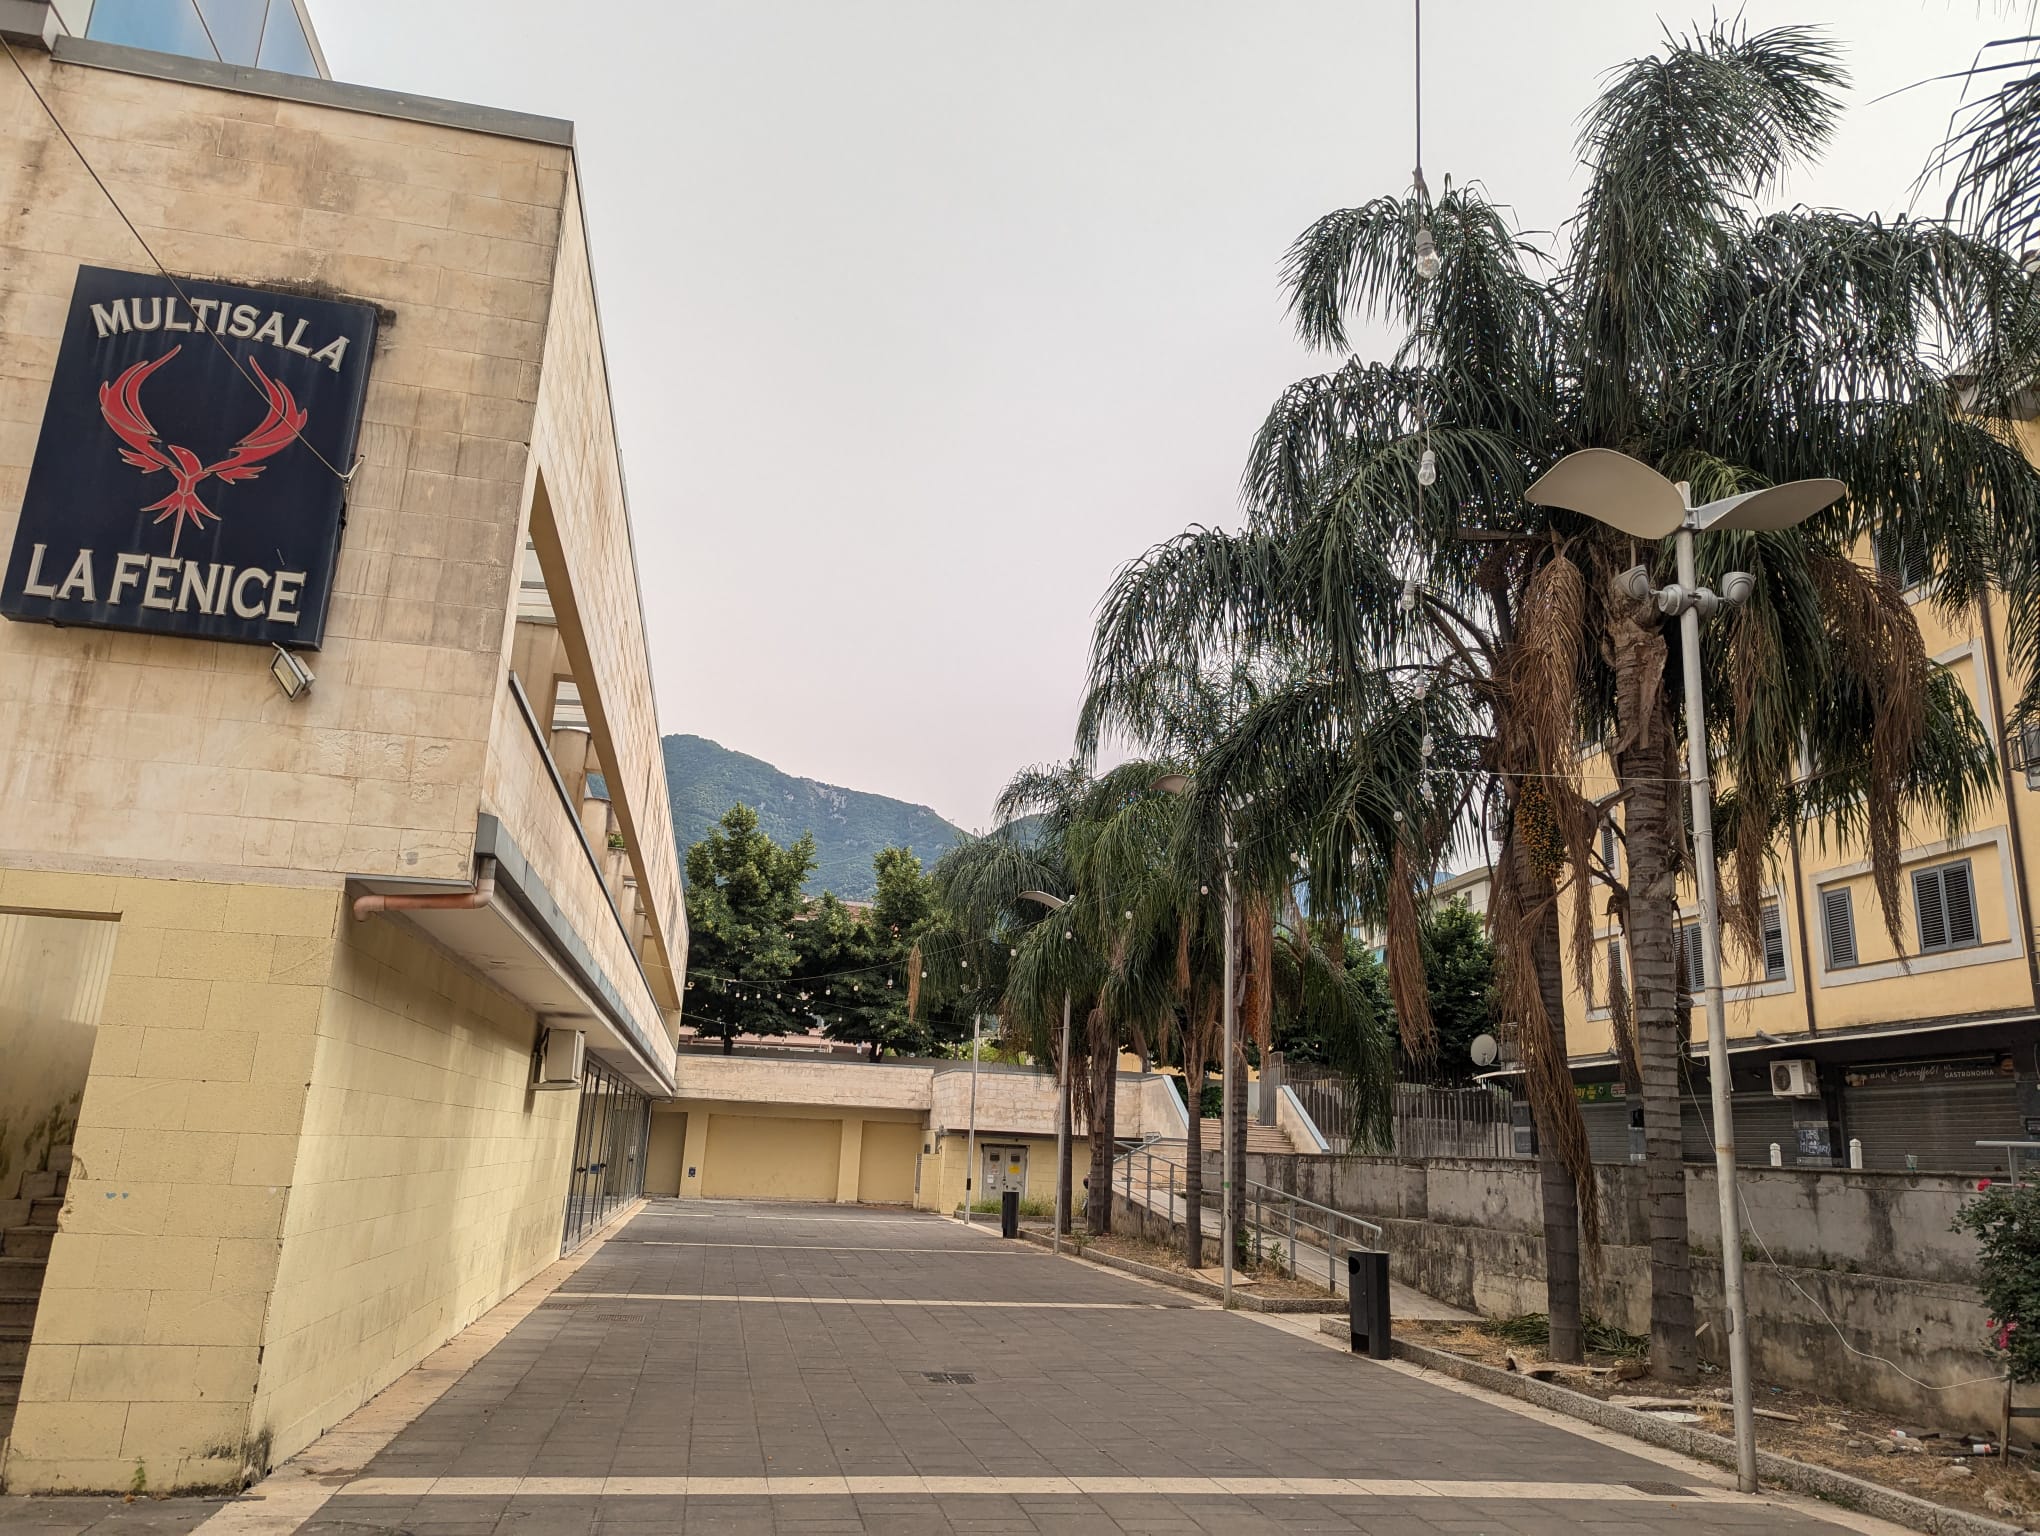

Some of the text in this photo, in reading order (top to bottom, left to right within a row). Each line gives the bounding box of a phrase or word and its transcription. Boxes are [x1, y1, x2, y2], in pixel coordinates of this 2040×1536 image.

[90, 297, 350, 372] MULTISALA
[23, 544, 307, 626] LA FENICE
[1944, 1070, 1994, 1079] GASTRONOMIA
